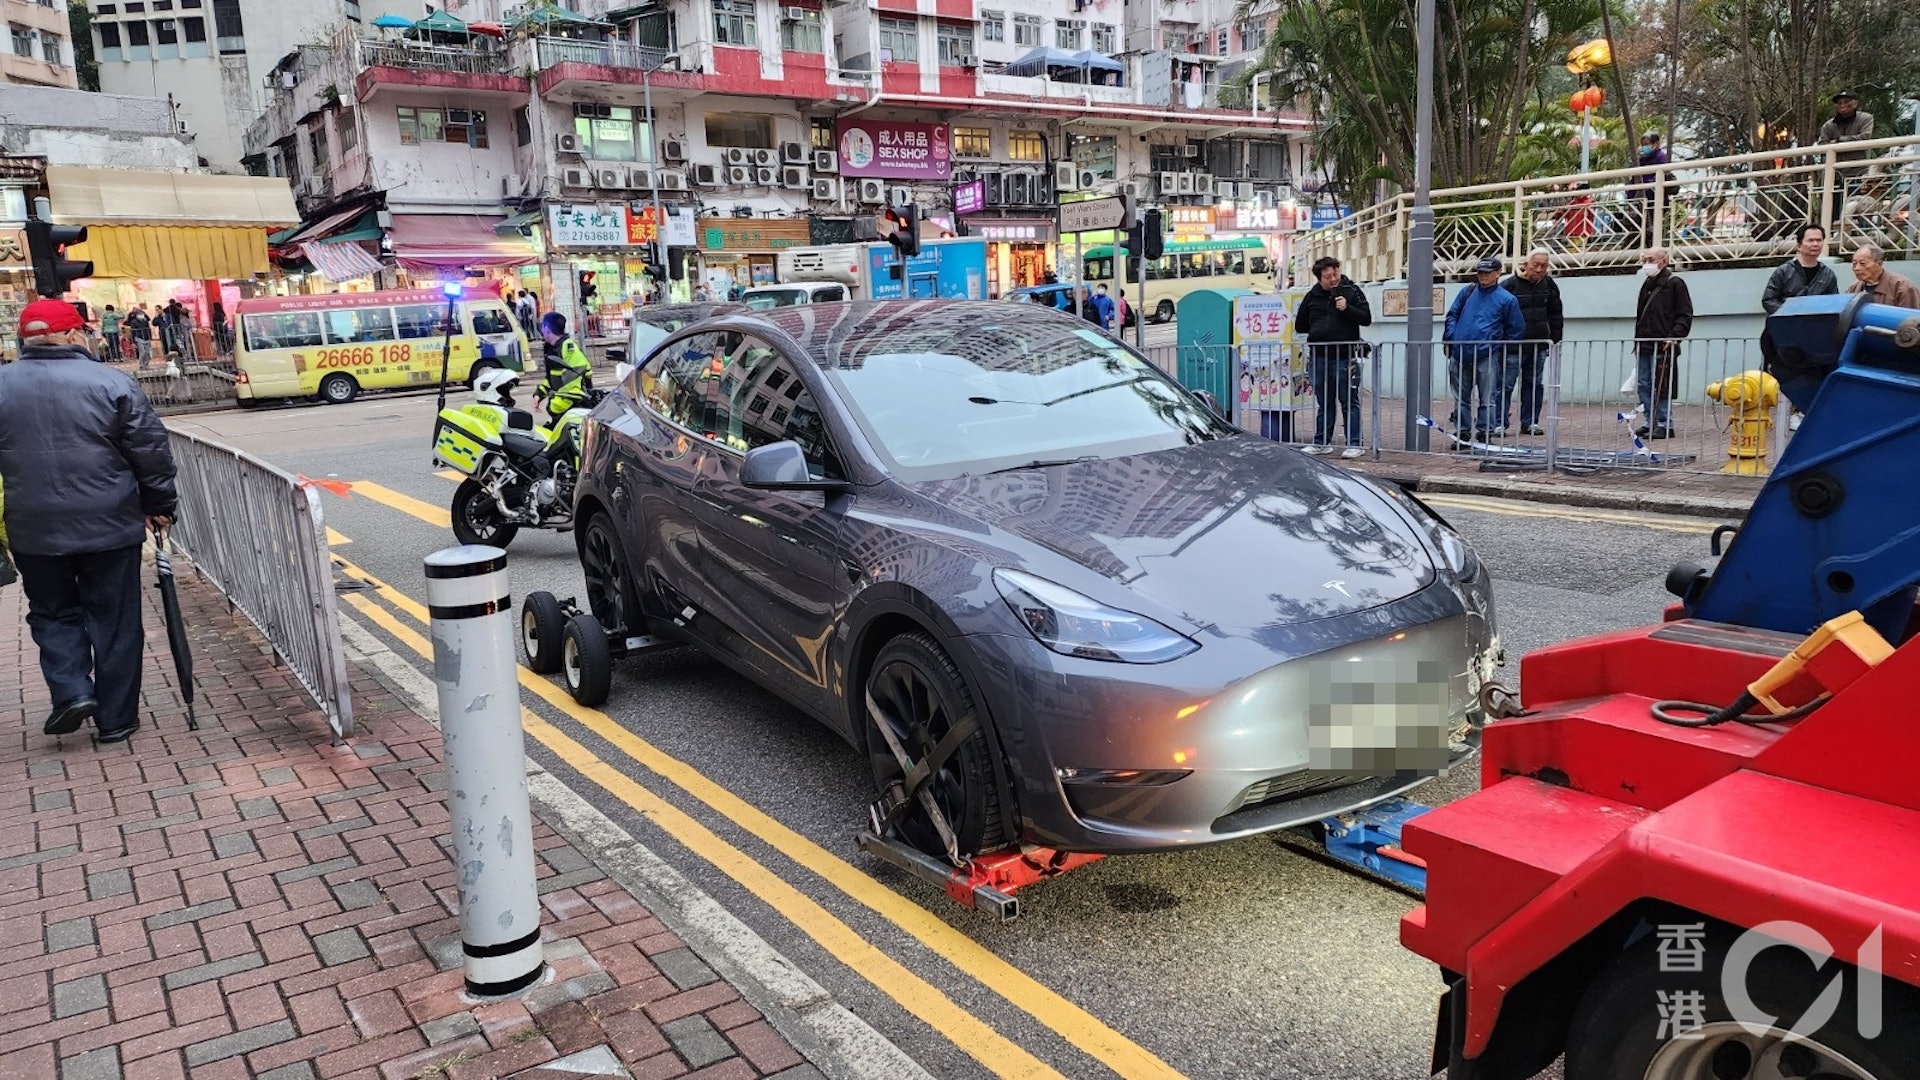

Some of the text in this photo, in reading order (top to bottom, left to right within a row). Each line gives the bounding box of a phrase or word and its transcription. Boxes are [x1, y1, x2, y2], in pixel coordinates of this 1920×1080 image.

[878, 130, 929, 147] 成人用品
[878, 147, 929, 159] SEX SHOP
[1078, 205, 1091, 213] Wah
[1092, 202, 1112, 211] Street
[555, 210, 621, 228] 富安地產
[1075, 216, 1099, 228] 月華街
[572, 231, 620, 241] 27636887
[280, 301, 304, 309] PUBLIC
[308, 300, 326, 308] LIGHT
[1244, 312, 1281, 334] 招生
[316, 347, 374, 369] 26666
[379, 344, 411, 364] 168
